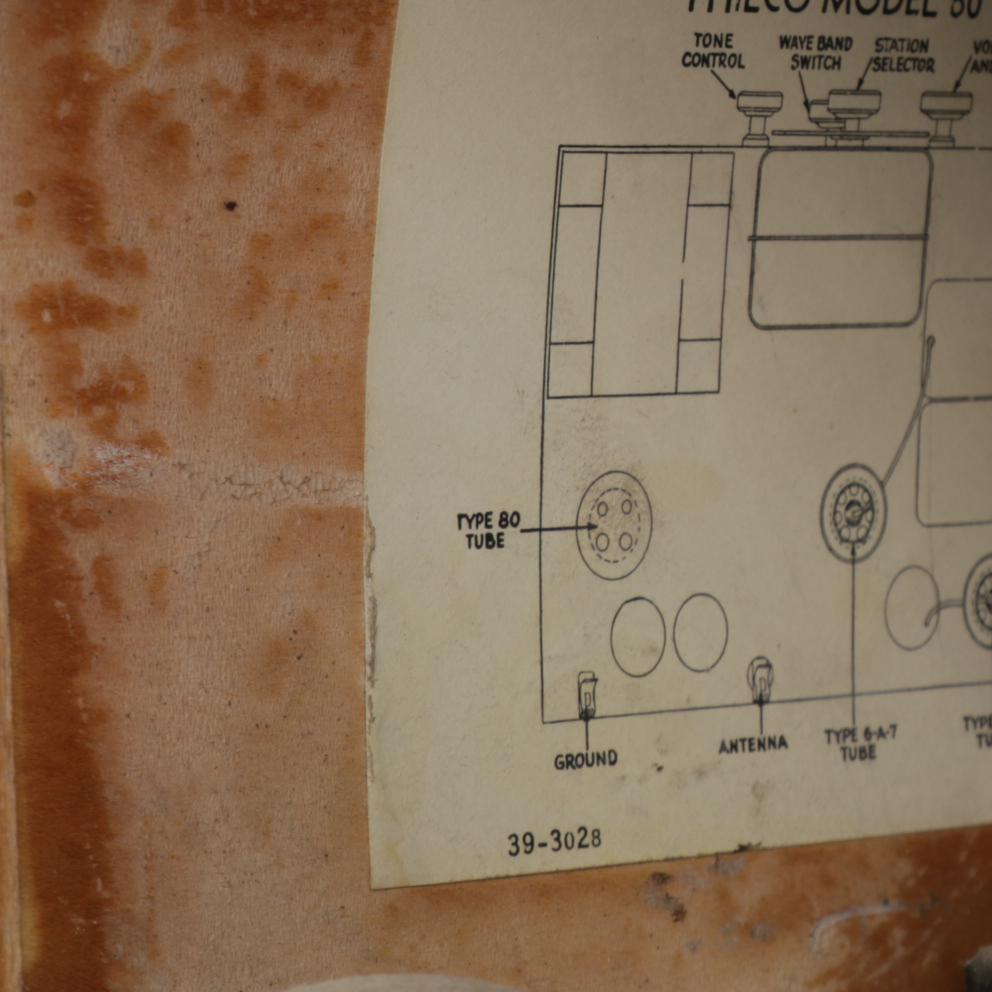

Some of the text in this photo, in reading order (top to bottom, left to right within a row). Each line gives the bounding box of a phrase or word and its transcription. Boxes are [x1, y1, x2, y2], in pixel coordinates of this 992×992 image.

[693, 33, 734, 49] TONE
[779, 34, 853, 53] WAVE BAND
[874, 37, 930, 54] STATION
[681, 50, 746, 70] CONTROL
[789, 53, 842, 72] SWITCH
[872, 55, 936, 74] SELECTOR
[457, 510, 521, 530] TYPE 80
[465, 533, 505, 549] TUBE
[718, 735, 789, 755] ANTENNA
[824, 728, 858, 745] TYPE
[554, 749, 618, 771] GROUND
[840, 745, 877, 762] TUBE
[507, 826, 602, 858] 39-3028
